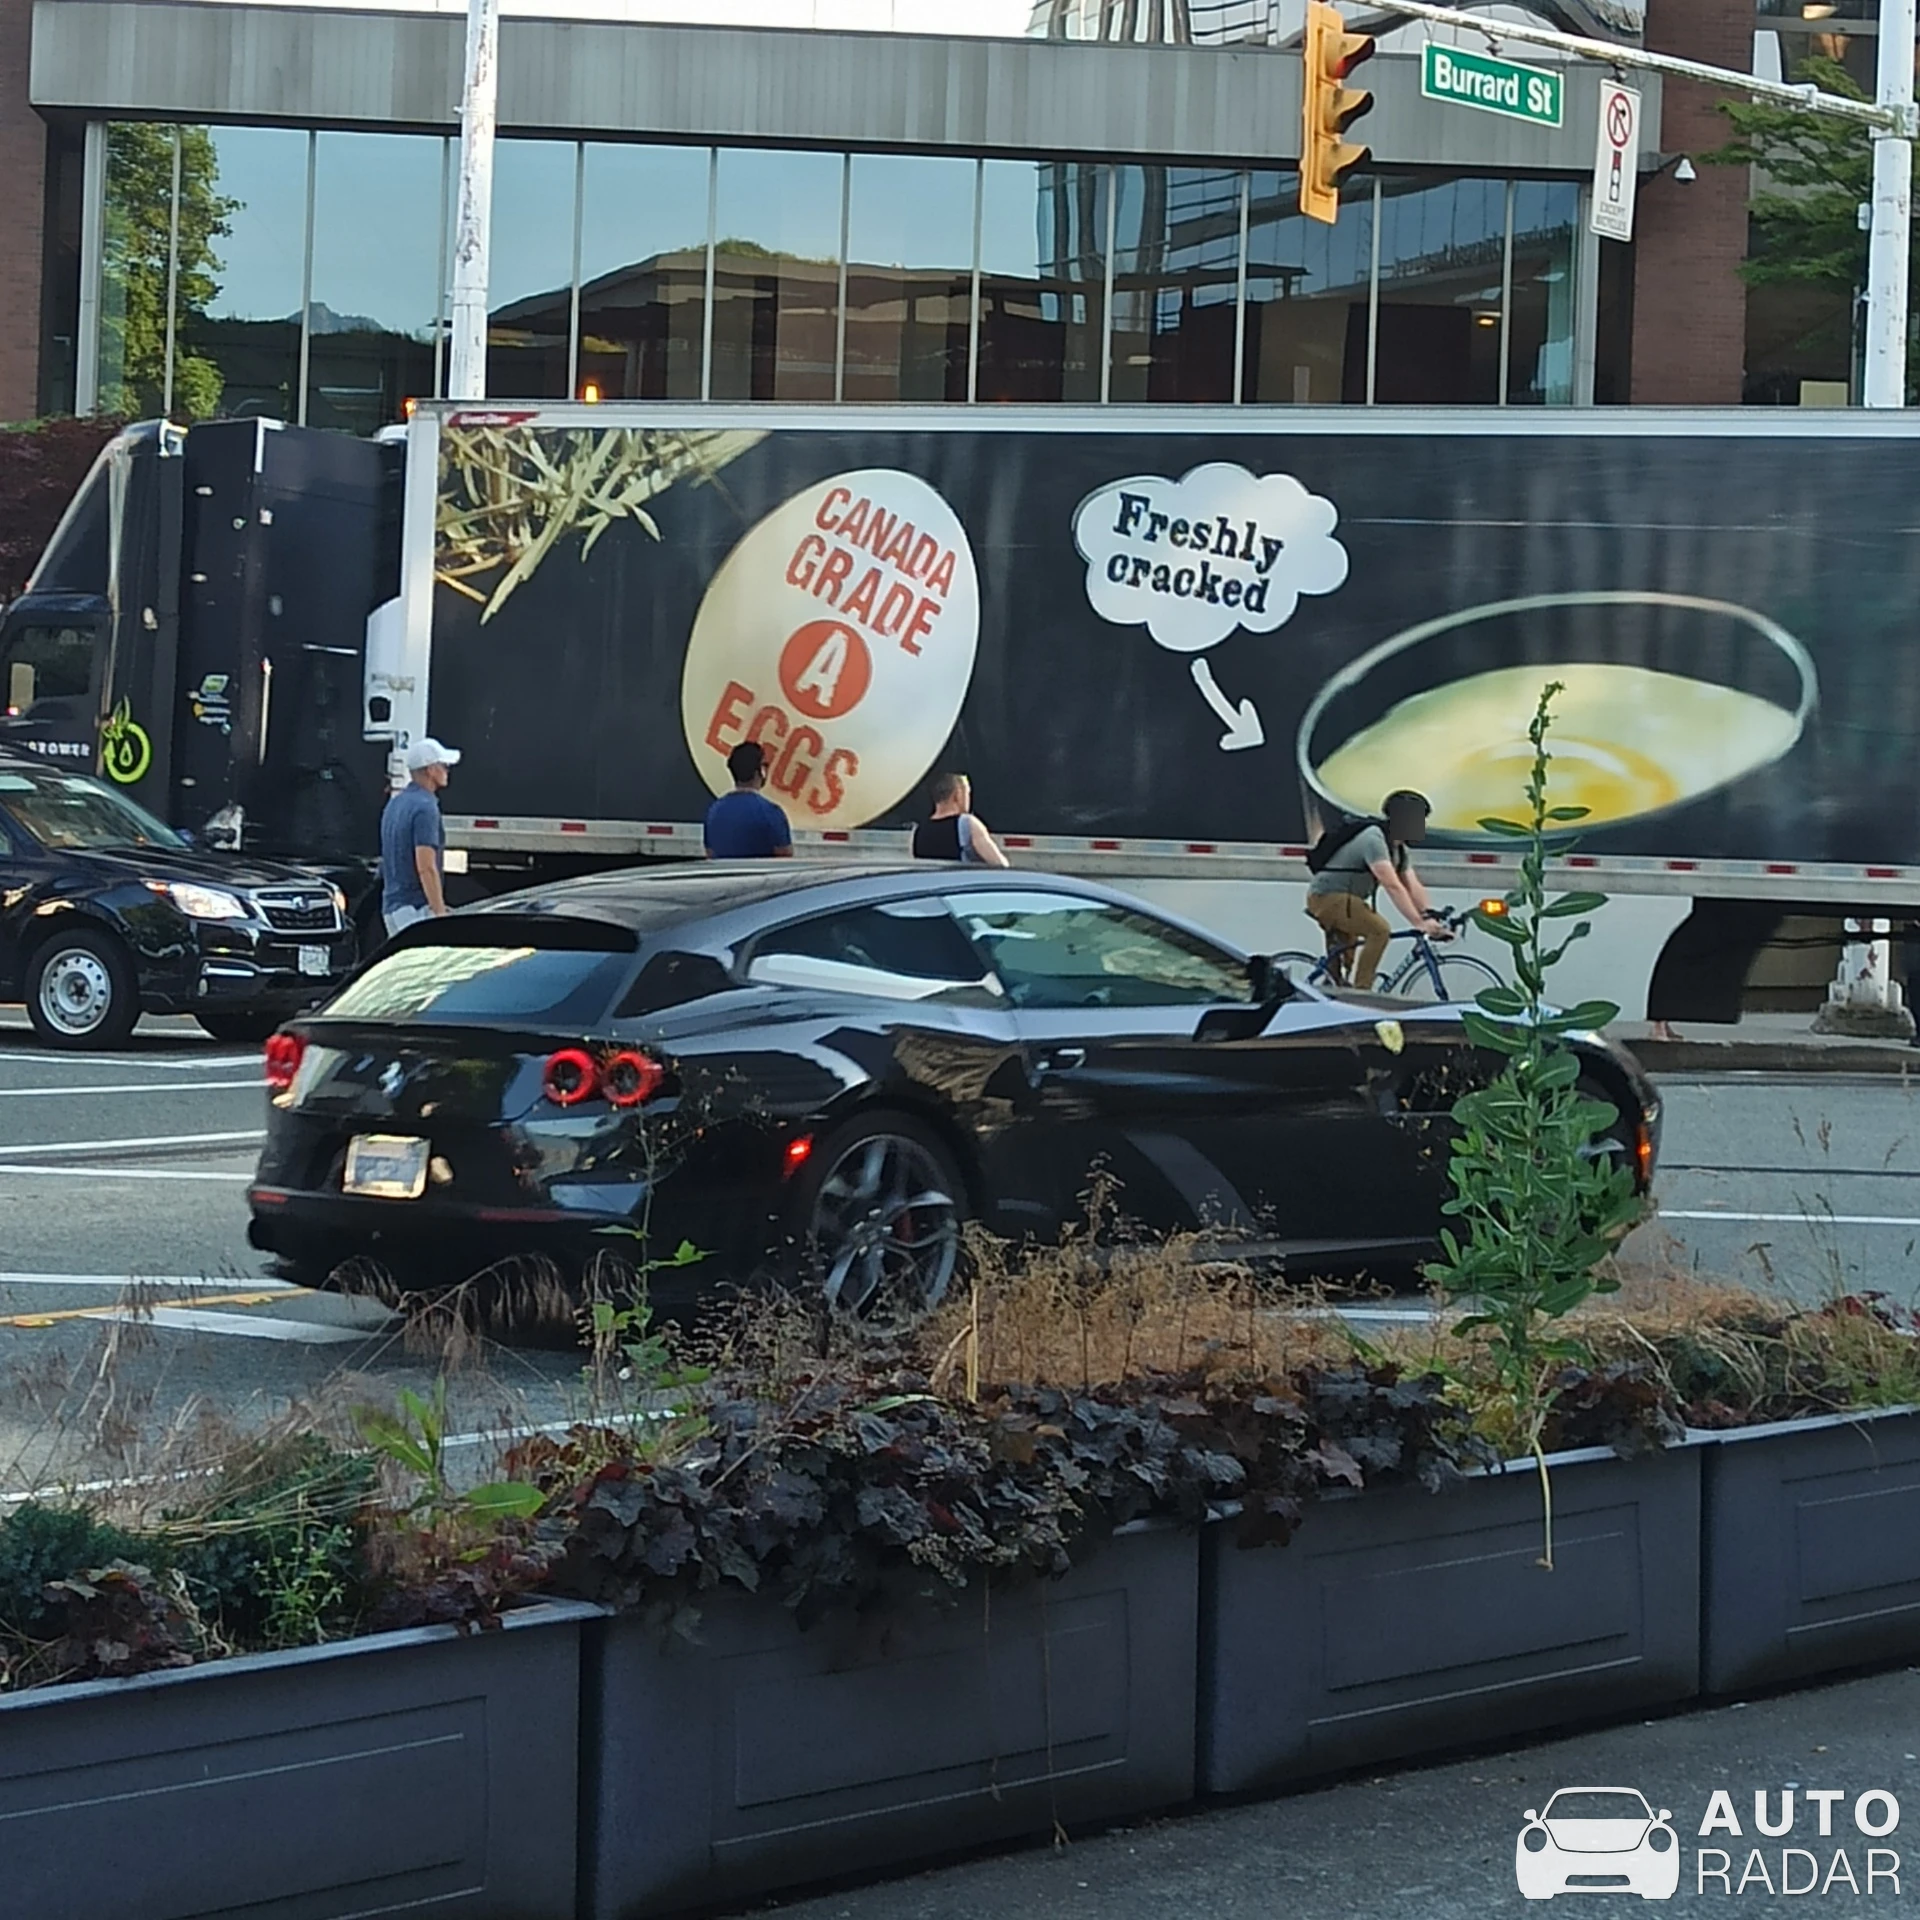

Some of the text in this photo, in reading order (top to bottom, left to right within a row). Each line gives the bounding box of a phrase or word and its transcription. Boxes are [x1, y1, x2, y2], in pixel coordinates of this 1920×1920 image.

[1434, 53, 1552, 115] Burrard St
[815, 487, 956, 597] CANADA
[1113, 491, 1284, 574] Freshly
[785, 533, 942, 657] GRADE
[1107, 553, 1271, 614] cracked
[795, 628, 850, 707] A
[705, 680, 859, 815] EGGS
